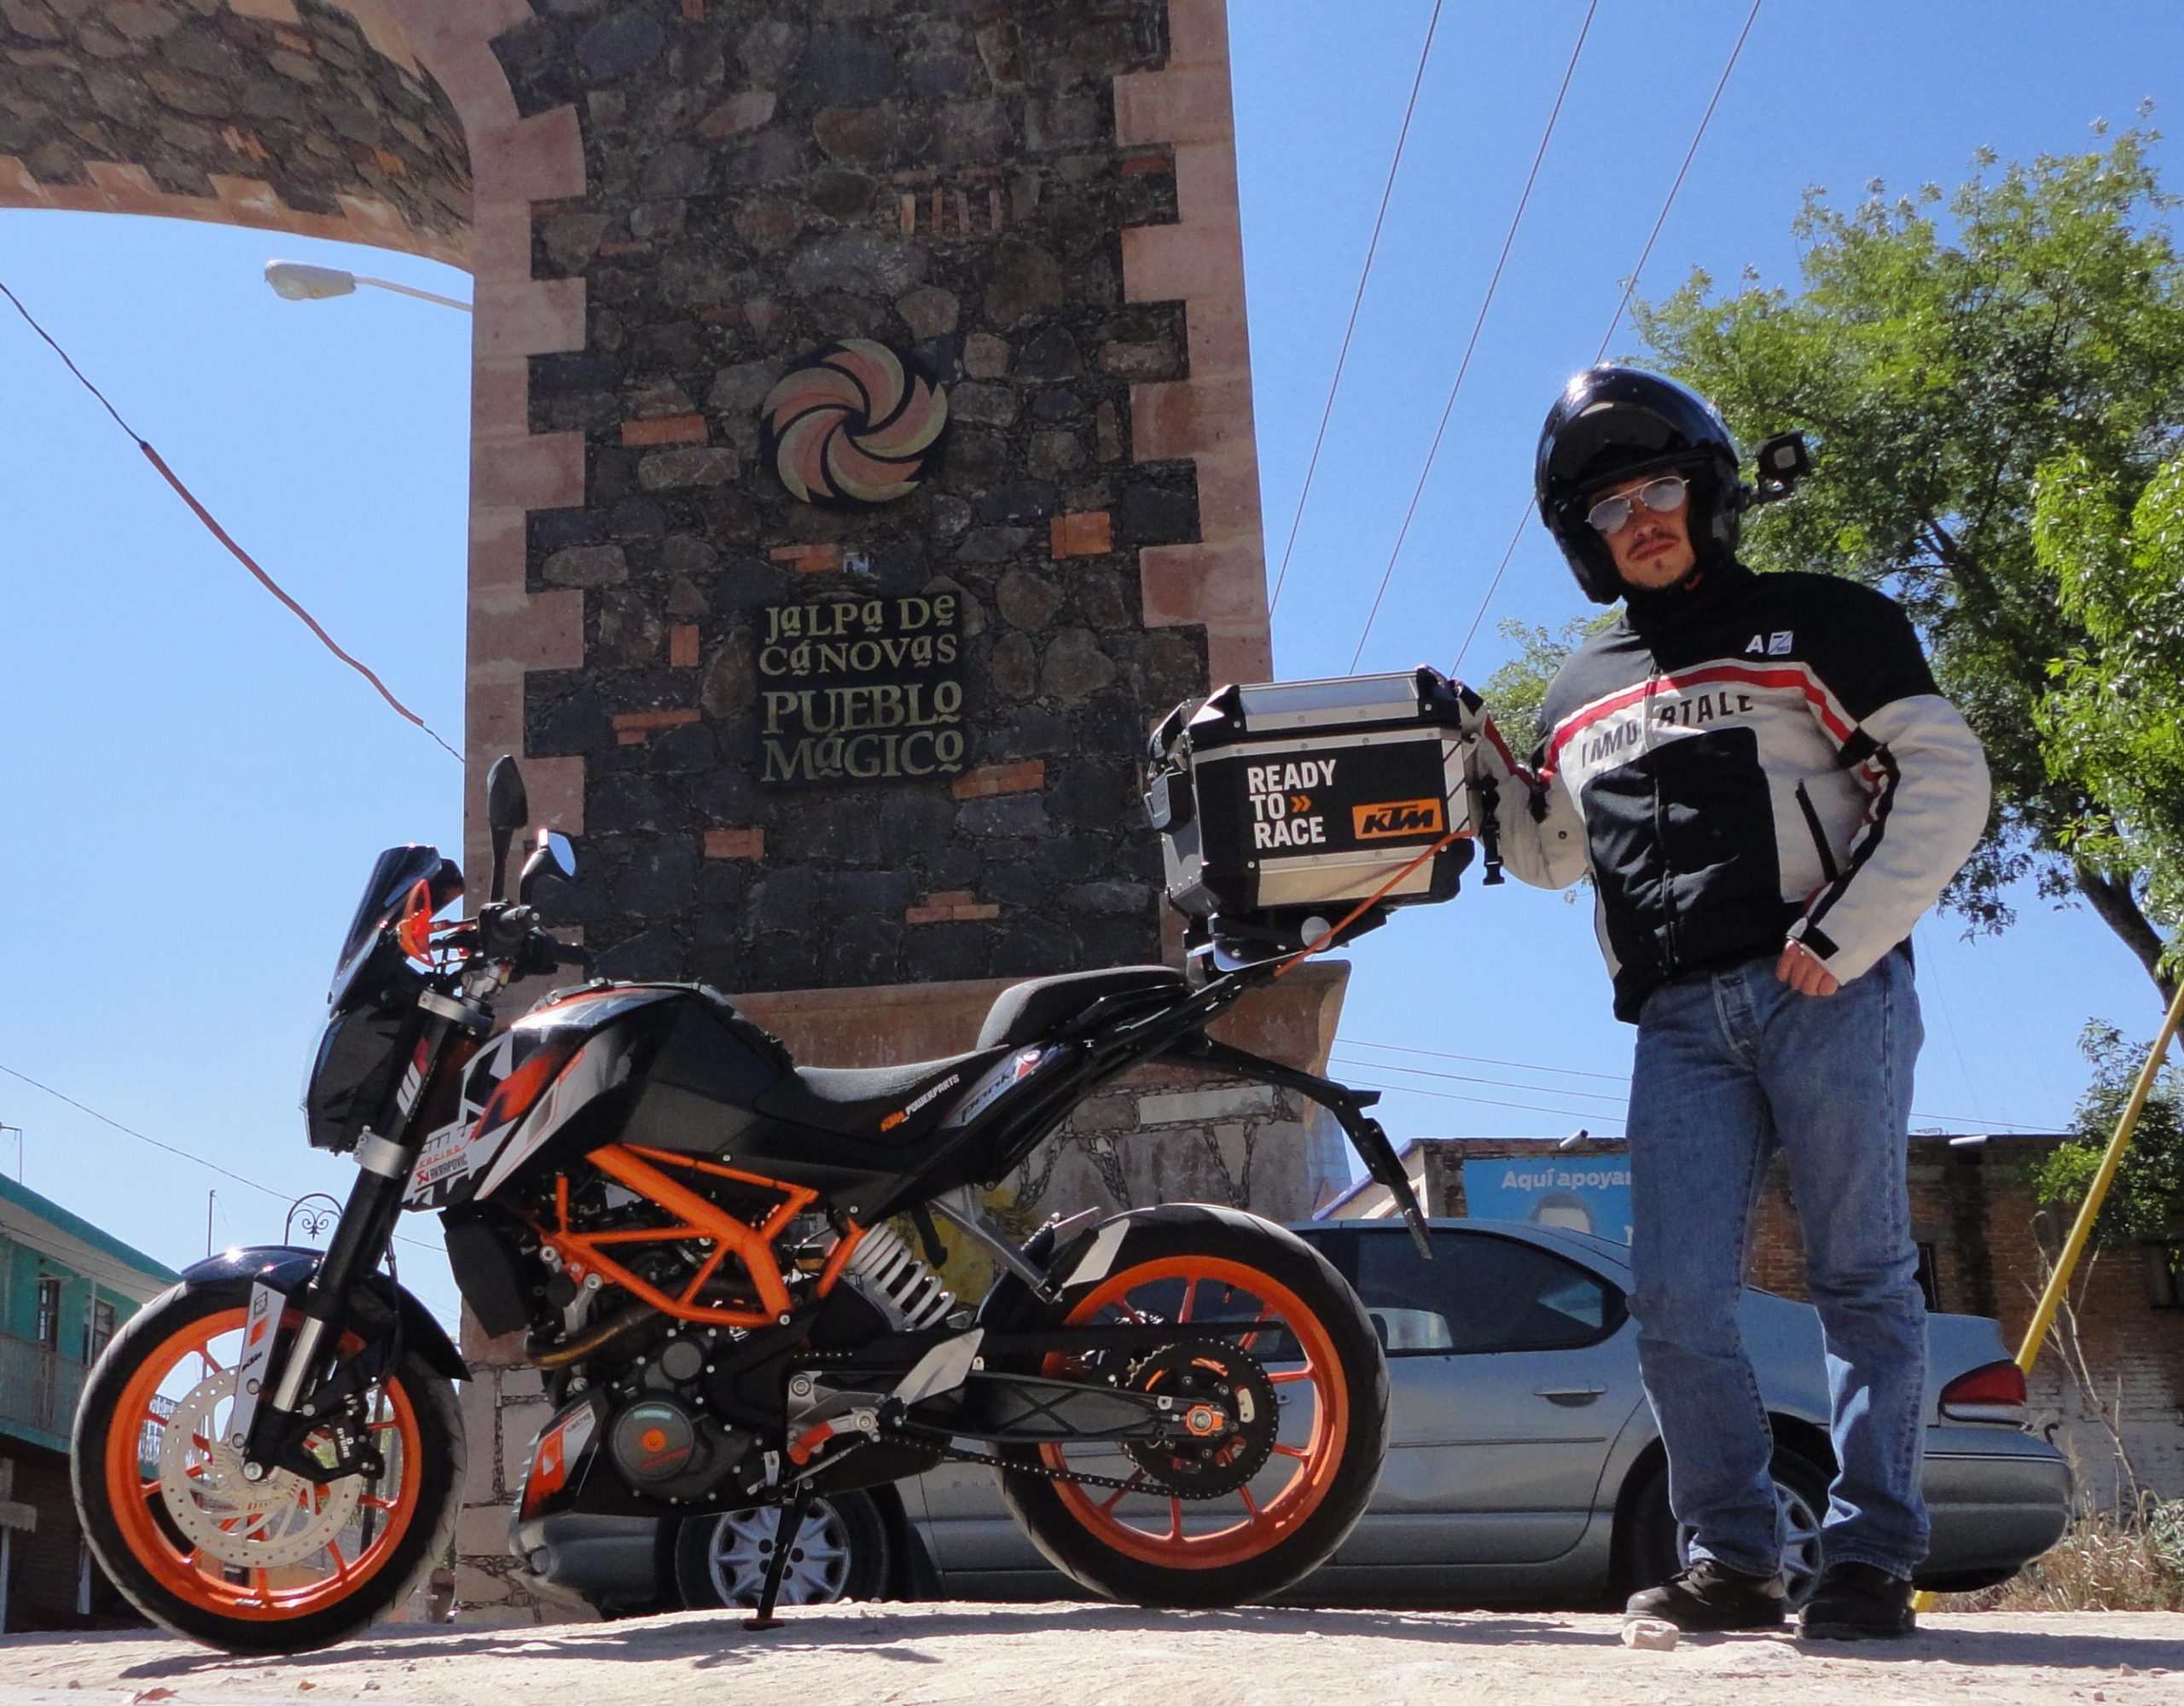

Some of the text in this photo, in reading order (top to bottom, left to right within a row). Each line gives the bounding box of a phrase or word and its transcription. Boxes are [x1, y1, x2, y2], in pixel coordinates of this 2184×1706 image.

[1247, 759, 1337, 794] READY
[1249, 792, 1286, 822] TO
[1361, 804, 1435, 835] KTM
[1253, 816, 1327, 850] RACE
[904, 1073, 961, 1114] POWERPARTS
[1502, 1168, 1555, 1192] Aquí
